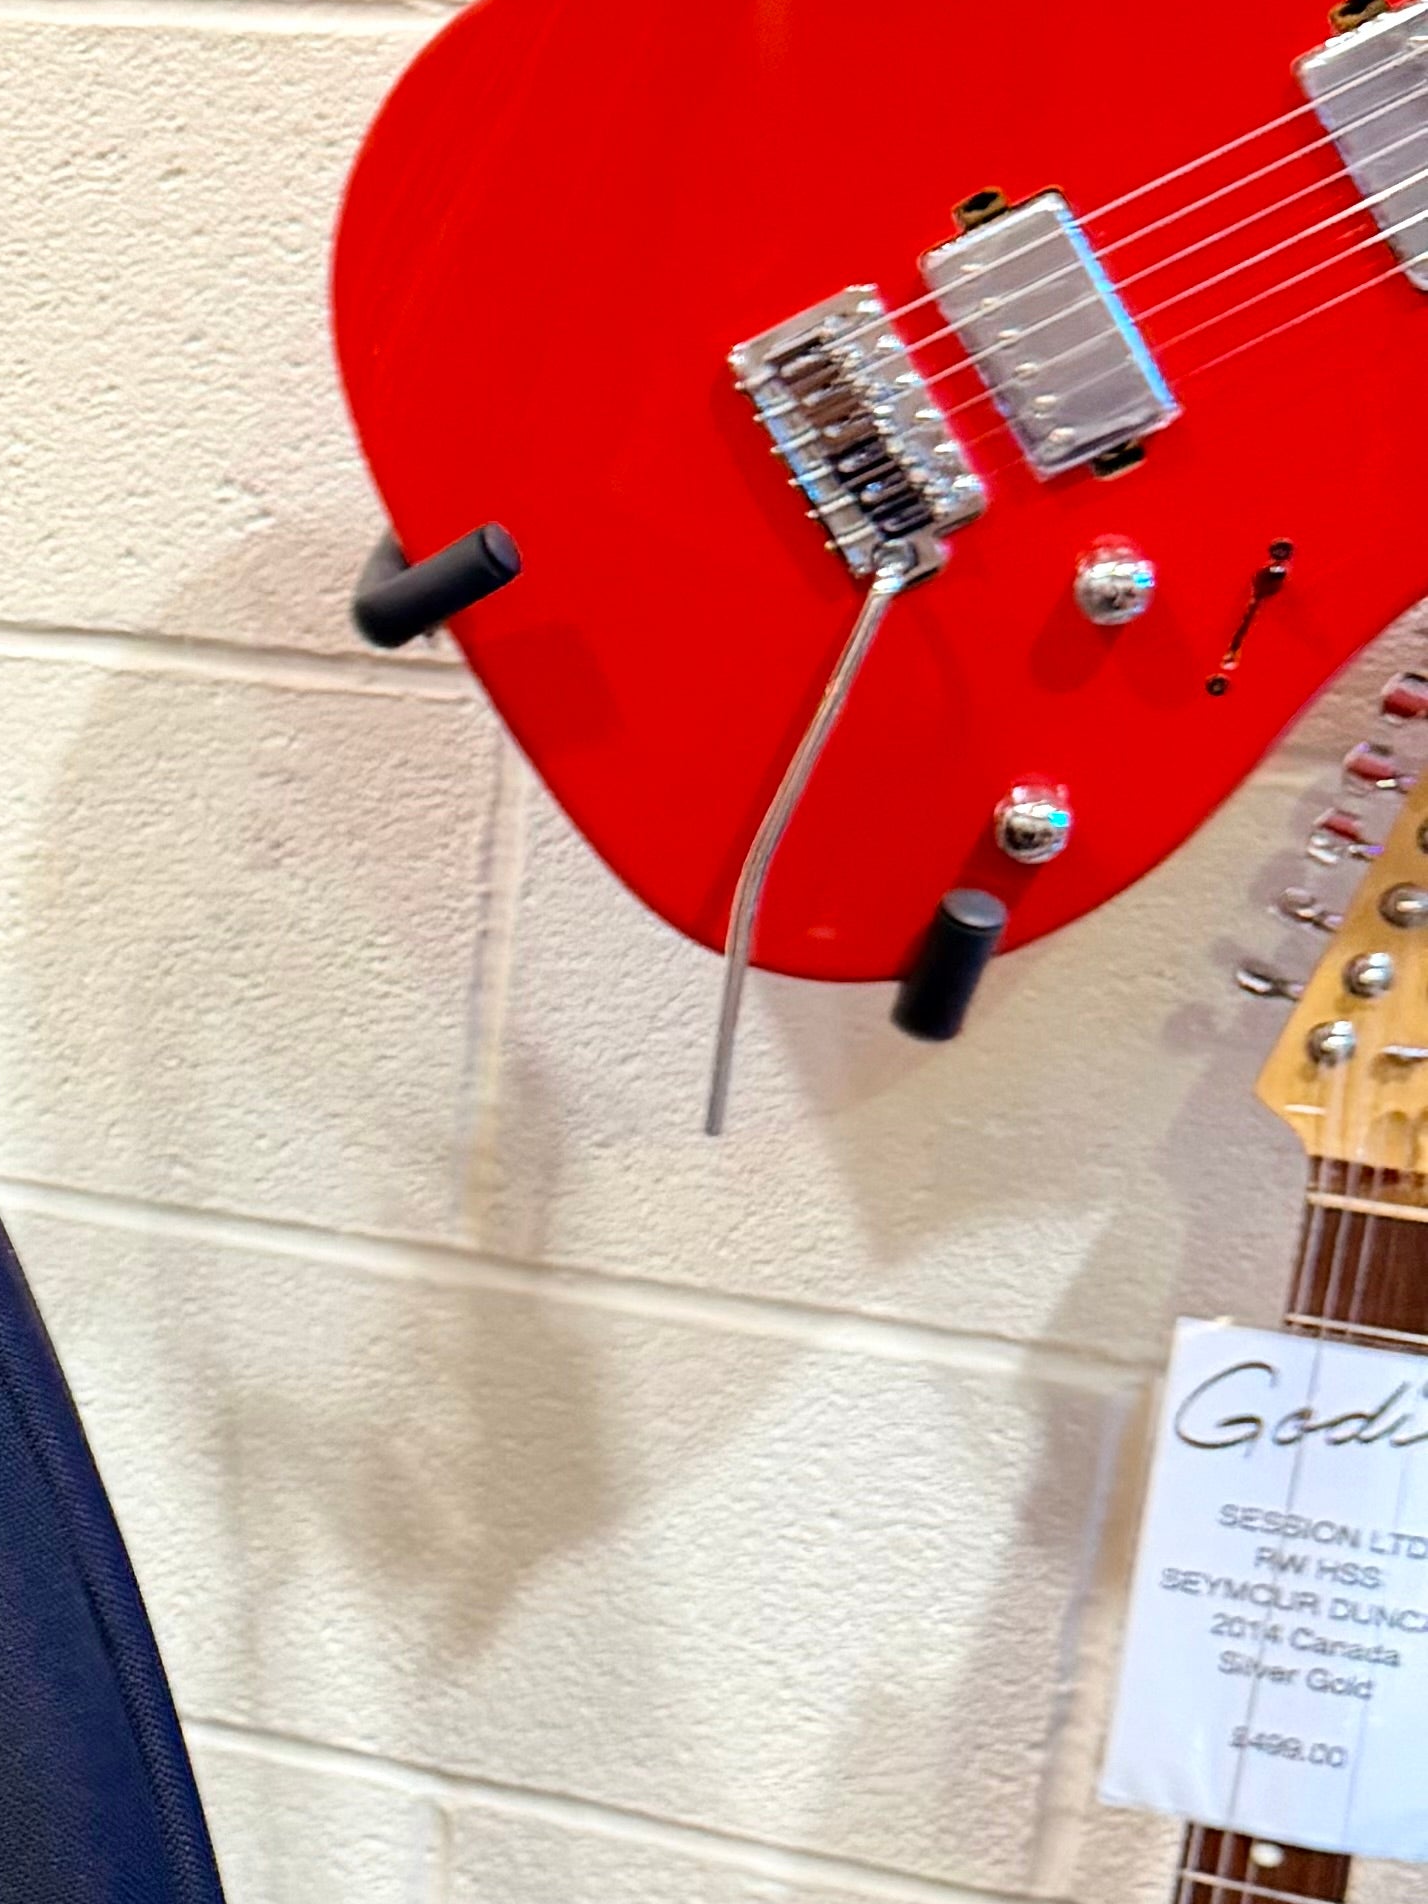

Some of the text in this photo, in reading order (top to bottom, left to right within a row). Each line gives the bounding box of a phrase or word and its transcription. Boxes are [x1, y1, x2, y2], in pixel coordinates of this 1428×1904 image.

[1217, 1503, 1428, 1560] SESSION LTD
[1159, 1568, 1322, 1615] SEYMOUR
[1254, 1546, 1387, 1590] RW HSS
[1210, 1612, 1401, 1667] 2014 Canada
[1217, 1650, 1375, 1701] Silver Gold
